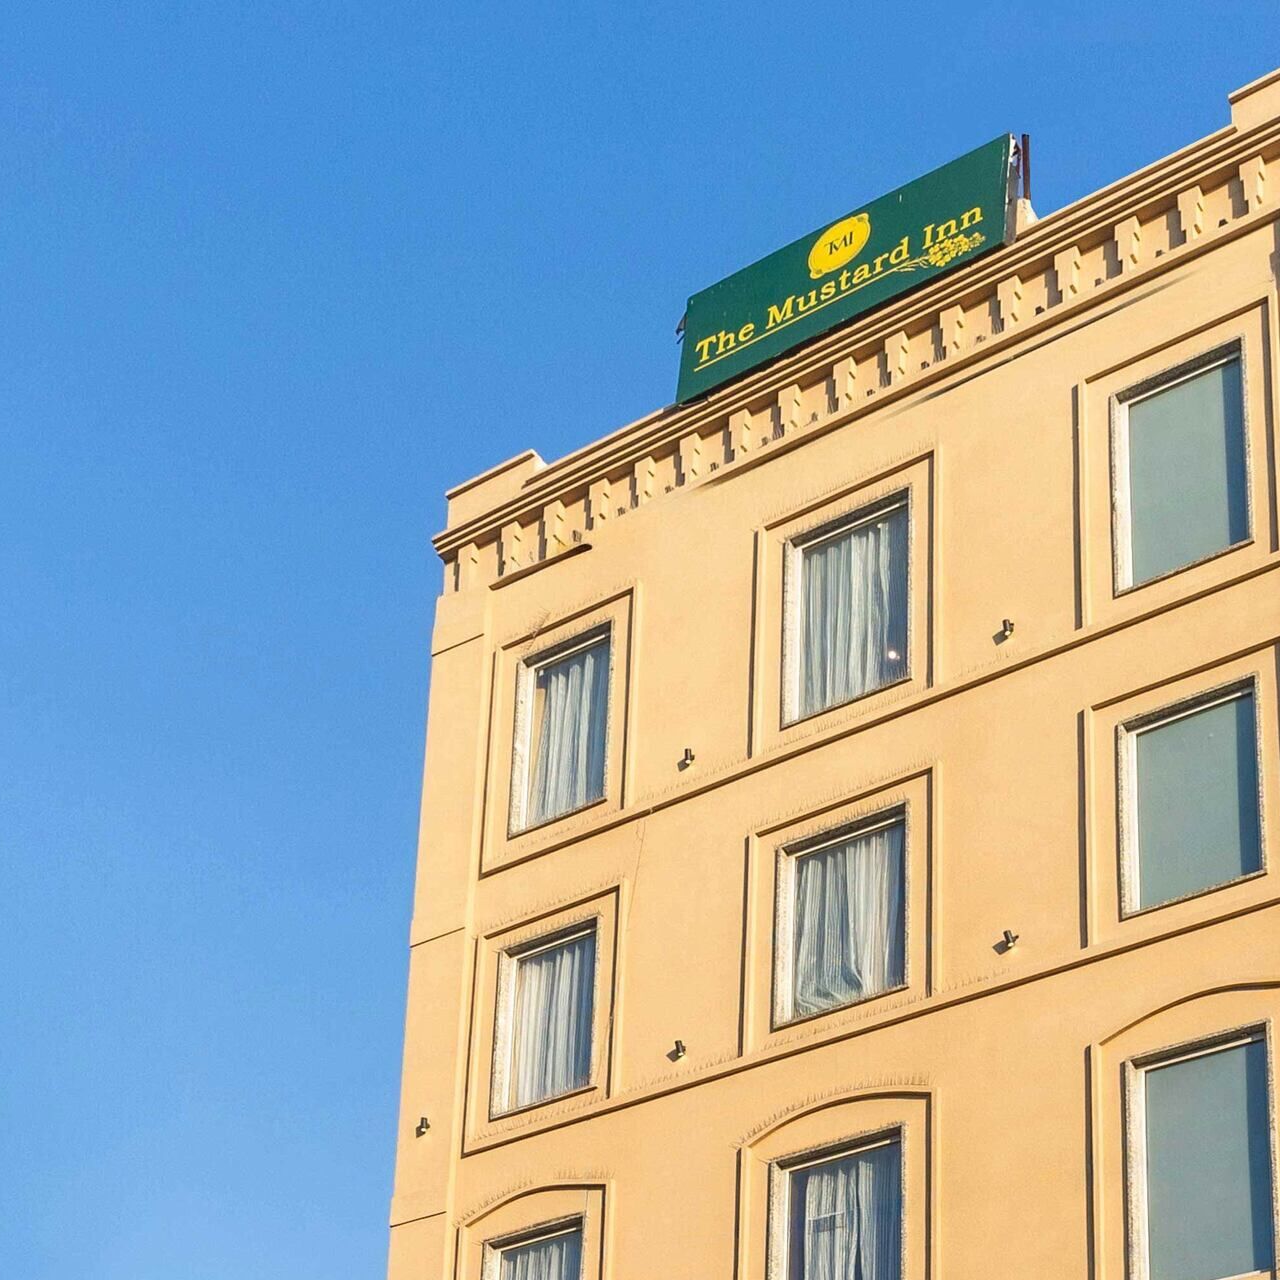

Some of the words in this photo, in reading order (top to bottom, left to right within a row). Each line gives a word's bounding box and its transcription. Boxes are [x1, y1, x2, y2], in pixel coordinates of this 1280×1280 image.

[694, 320, 755, 364] The
[765, 236, 910, 331] Mustard
[922, 205, 984, 251] Inn
